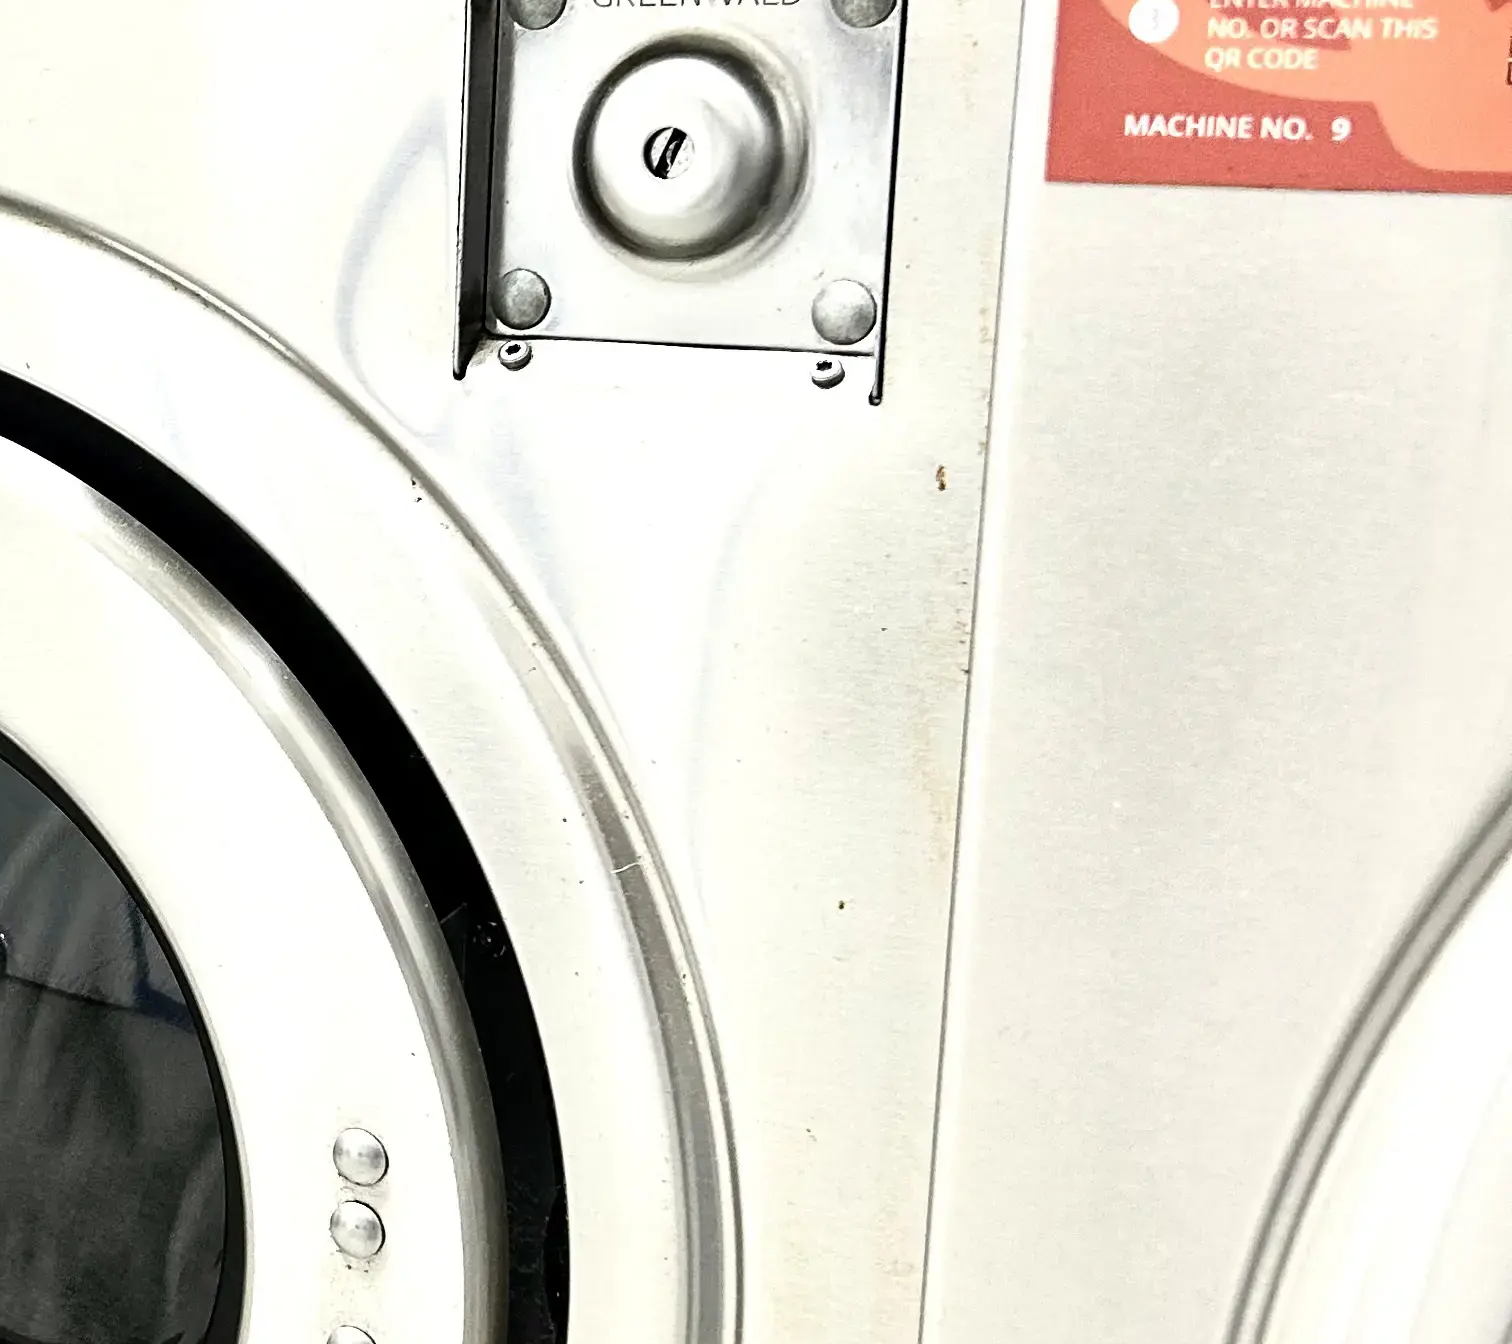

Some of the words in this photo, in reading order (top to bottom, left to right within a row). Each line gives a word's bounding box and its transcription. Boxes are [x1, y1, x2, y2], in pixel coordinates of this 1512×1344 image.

[1207, 17, 1252, 39] NO.
[1259, 18, 1297, 39] OR
[1303, 18, 1372, 40] SCAN
[1380, 17, 1439, 40] THIS
[1204, 47, 1241, 73] QR
[1247, 49, 1320, 70] CODE
[1124, 113, 1253, 139] MACHINE
[1259, 115, 1313, 140] NO.
[1330, 116, 1352, 143] 9
